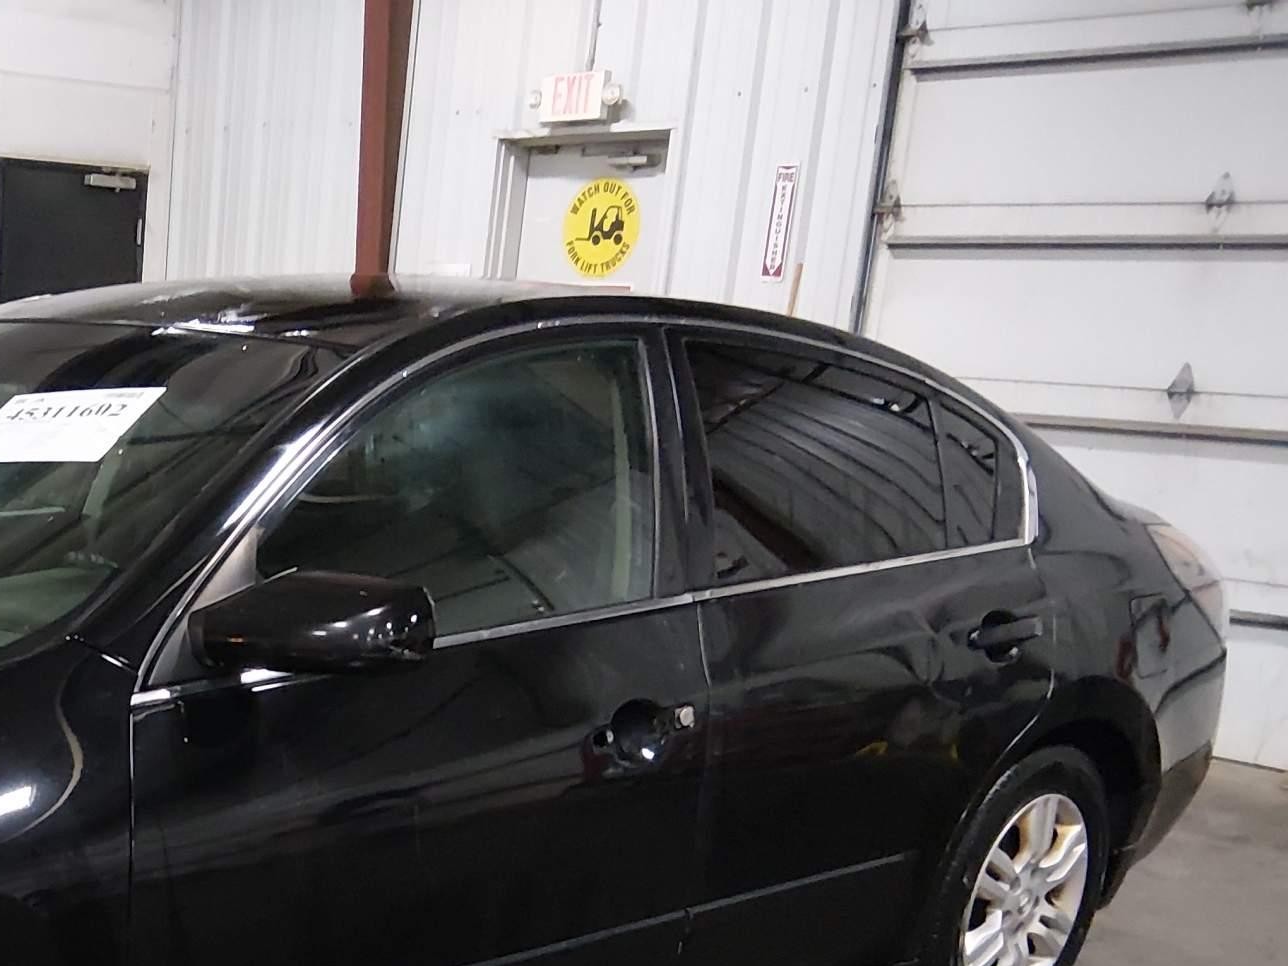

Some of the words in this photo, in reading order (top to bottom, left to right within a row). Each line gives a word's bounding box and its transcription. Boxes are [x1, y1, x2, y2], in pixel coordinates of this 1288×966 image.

[551, 73, 595, 116] EXIT
[776, 172, 795, 183] FIRE
[570, 182, 600, 215] WATCH
[603, 181, 622, 197] OUT
[620, 191, 636, 215] FOR
[566, 240, 581, 266] FORK
[580, 258, 598, 274] LIFT
[600, 241, 630, 273] TRUCKS
[6, 402, 128, 421] 45311602
